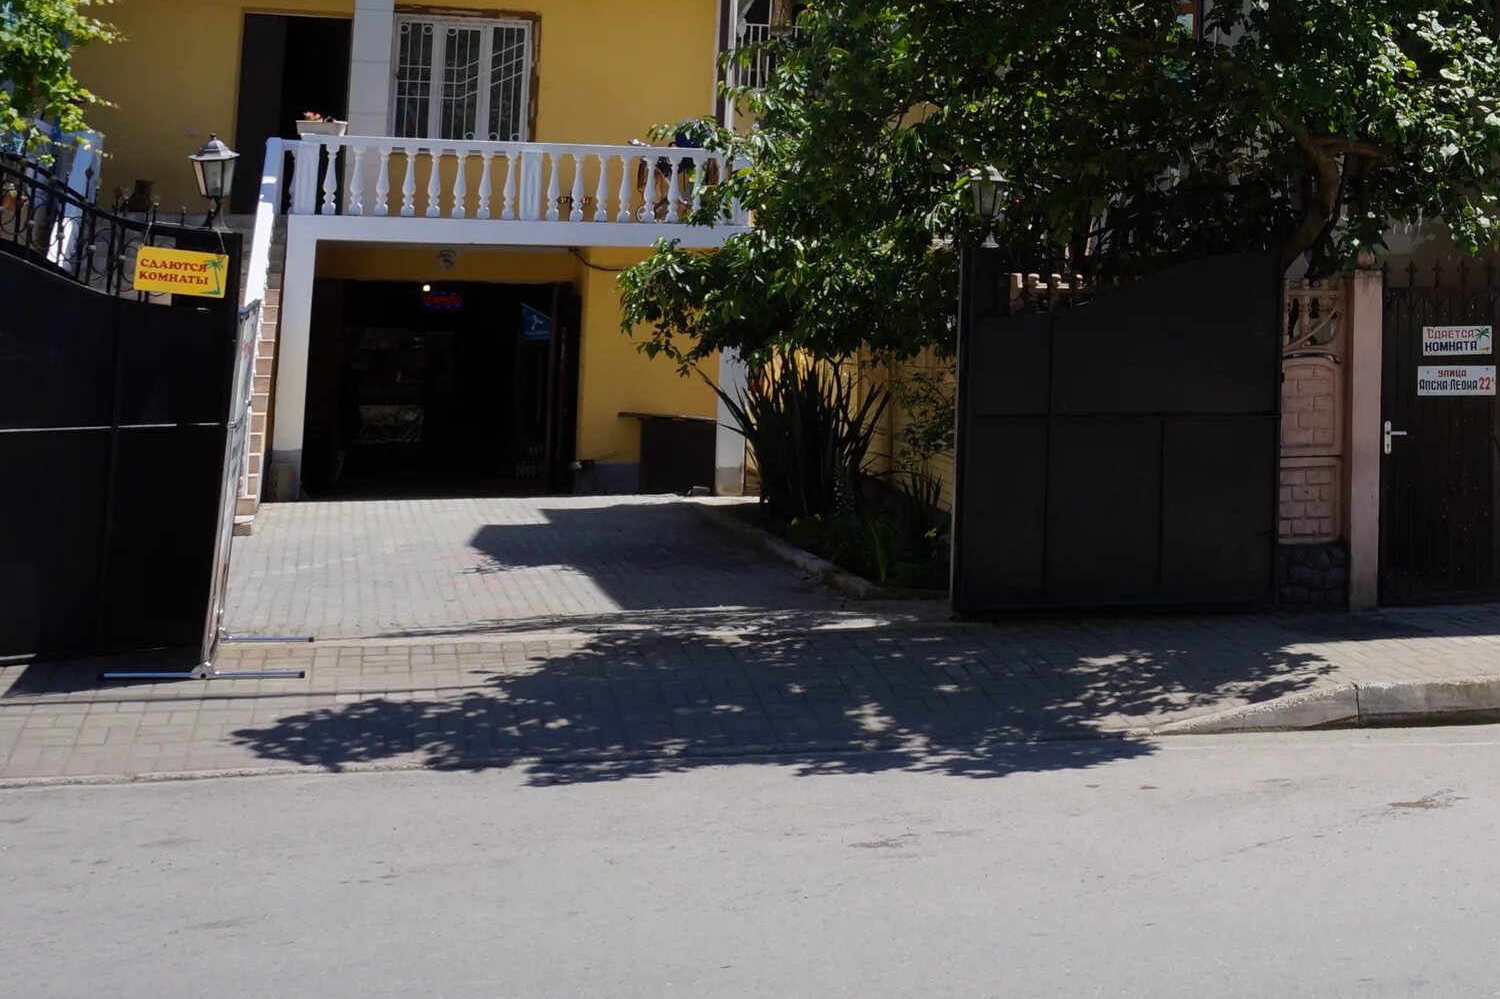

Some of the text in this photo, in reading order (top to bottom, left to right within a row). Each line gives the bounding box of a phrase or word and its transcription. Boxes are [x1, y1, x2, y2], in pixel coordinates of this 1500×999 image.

[140, 258, 207, 273] СДАЮТСЯ
[139, 270, 209, 285] КОМНАТЫ
[1425, 340, 1477, 352] КОМНАТА
[1437, 369, 1467, 379] УЛИЦА
